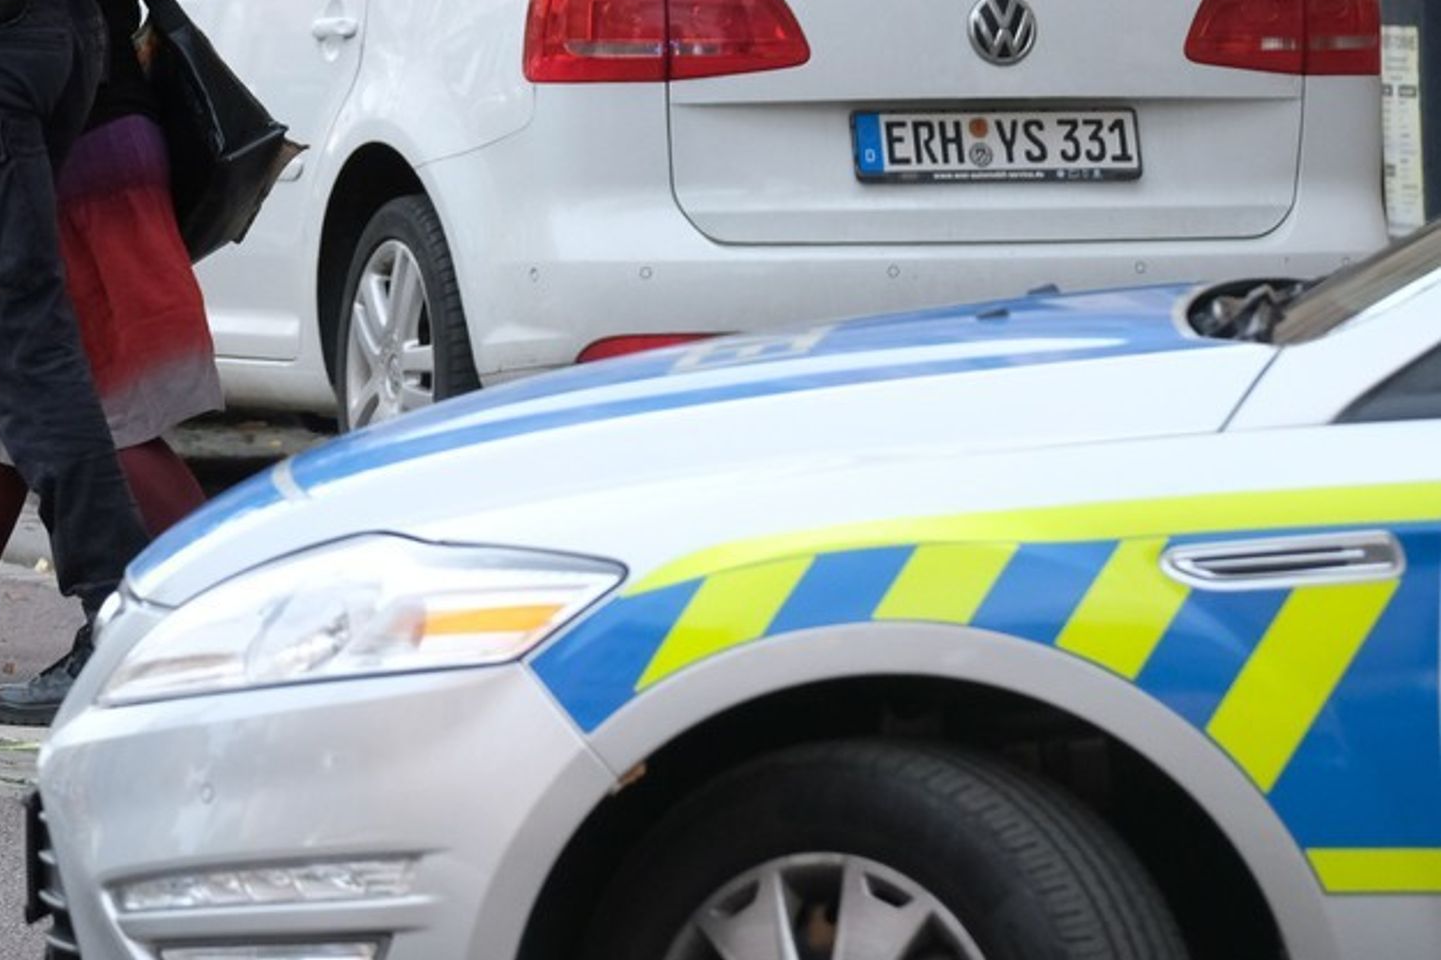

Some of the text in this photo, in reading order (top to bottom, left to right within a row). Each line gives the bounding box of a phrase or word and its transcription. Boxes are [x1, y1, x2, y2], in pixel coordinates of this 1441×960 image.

[884, 118, 1133, 165] ERH YS 331
